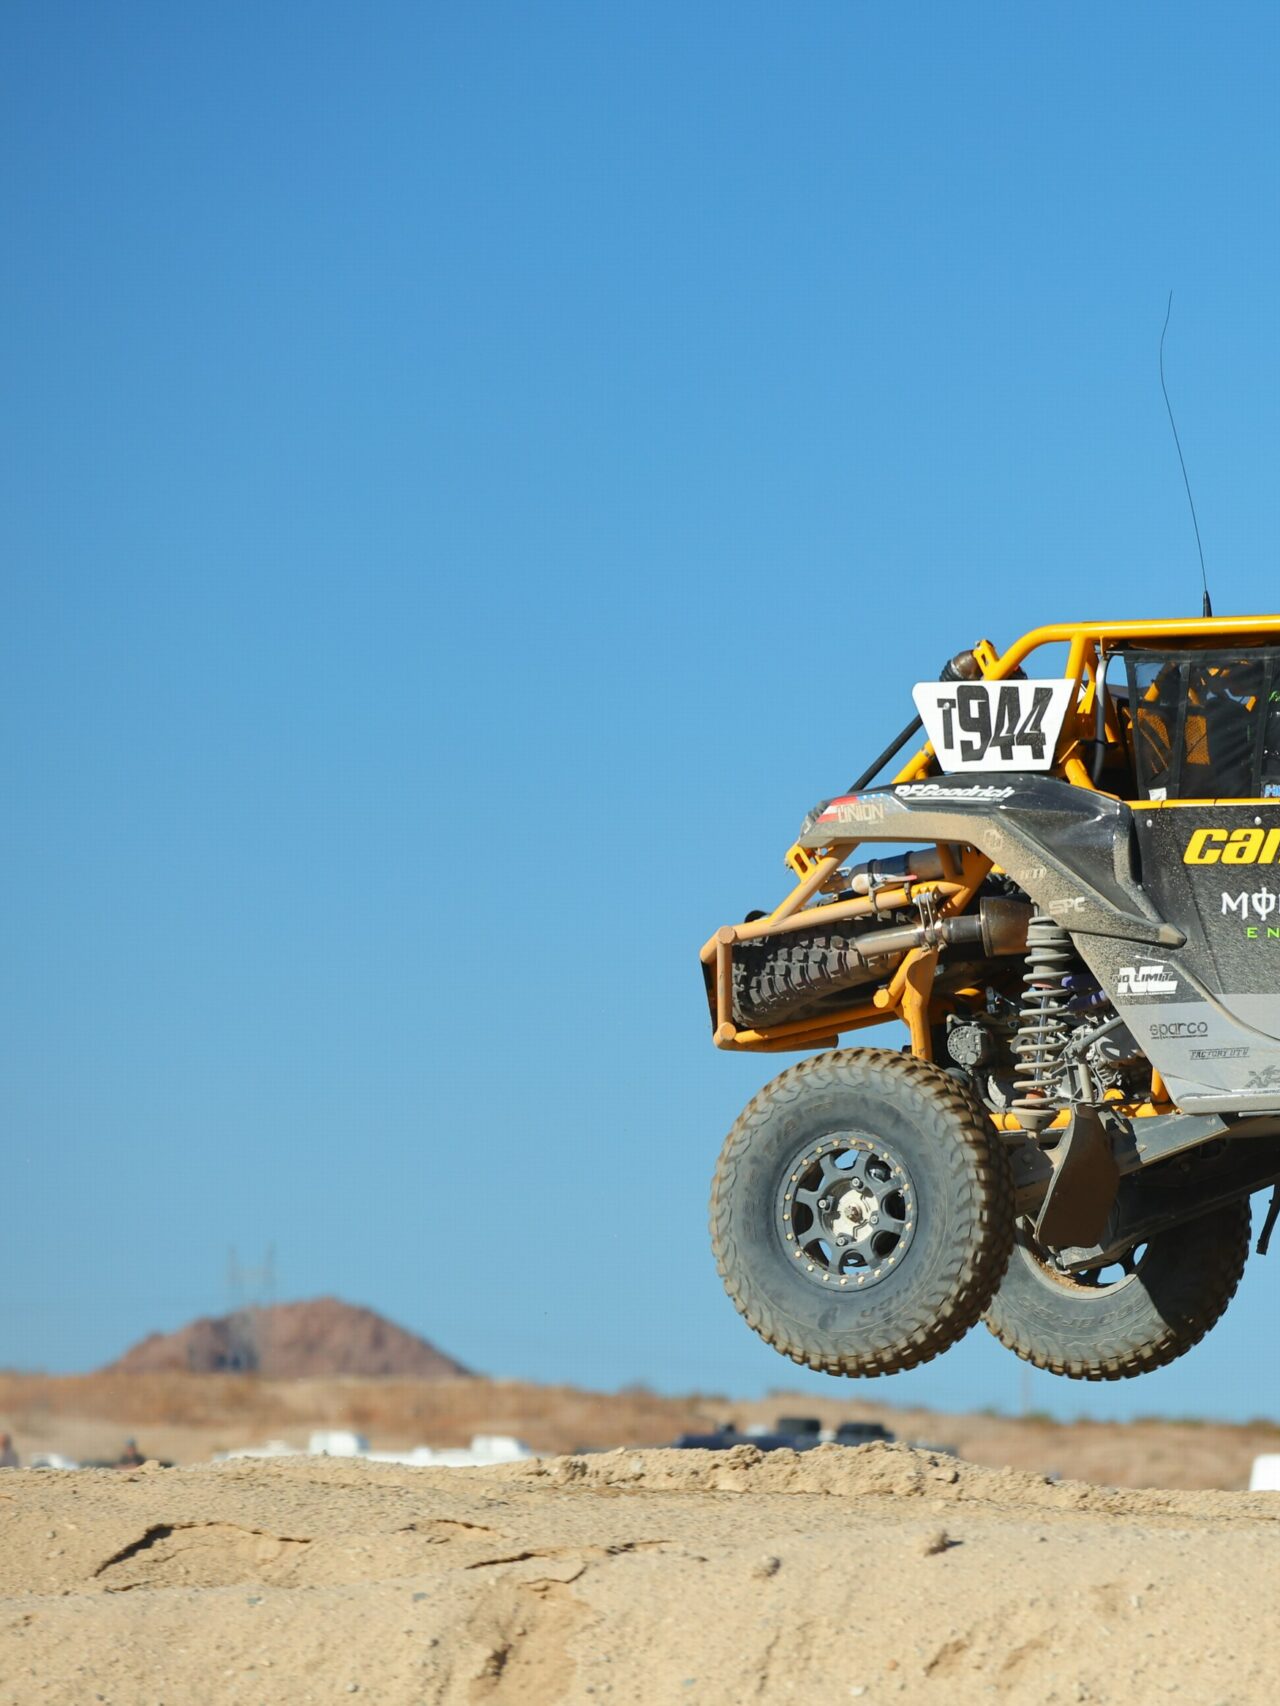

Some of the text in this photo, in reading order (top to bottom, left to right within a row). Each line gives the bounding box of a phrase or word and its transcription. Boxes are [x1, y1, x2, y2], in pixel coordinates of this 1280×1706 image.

[894, 783, 1015, 799] BFGoodrich
[837, 803, 885, 824] UNION
[1149, 1021, 1209, 1040] sparco
